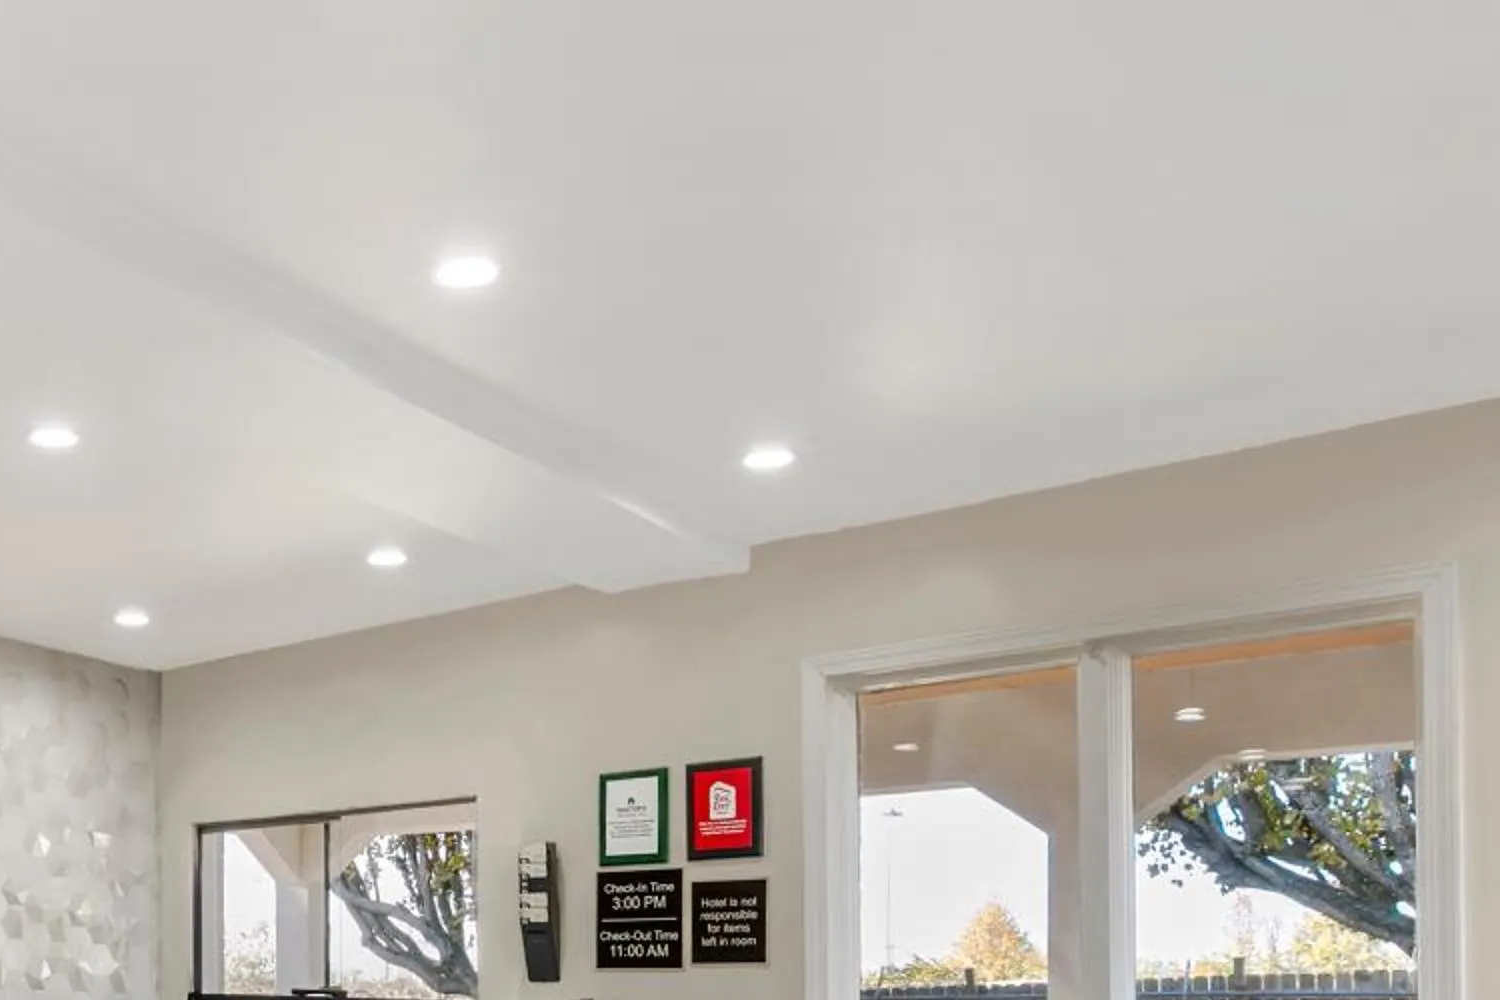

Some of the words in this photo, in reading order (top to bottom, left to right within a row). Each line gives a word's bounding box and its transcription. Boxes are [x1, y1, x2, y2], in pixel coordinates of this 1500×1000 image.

[650, 881, 675, 893] Time
[611, 894, 641, 911] 3:00
[643, 894, 667, 909] PM
[701, 897, 727, 909] Hotel
[729, 896, 739, 907] is
[740, 896, 757, 907] not
[700, 909, 759, 922] responsible
[707, 923, 721, 934] for
[723, 923, 751, 933] items
[599, 930, 653, 942] Check-Out
[654, 929, 679, 942] Time
[701, 936, 717, 947] left
[719, 936, 729, 946] in
[730, 937, 757, 947] room
[610, 943, 645, 958] 11:00
[645, 943, 669, 957] AM
